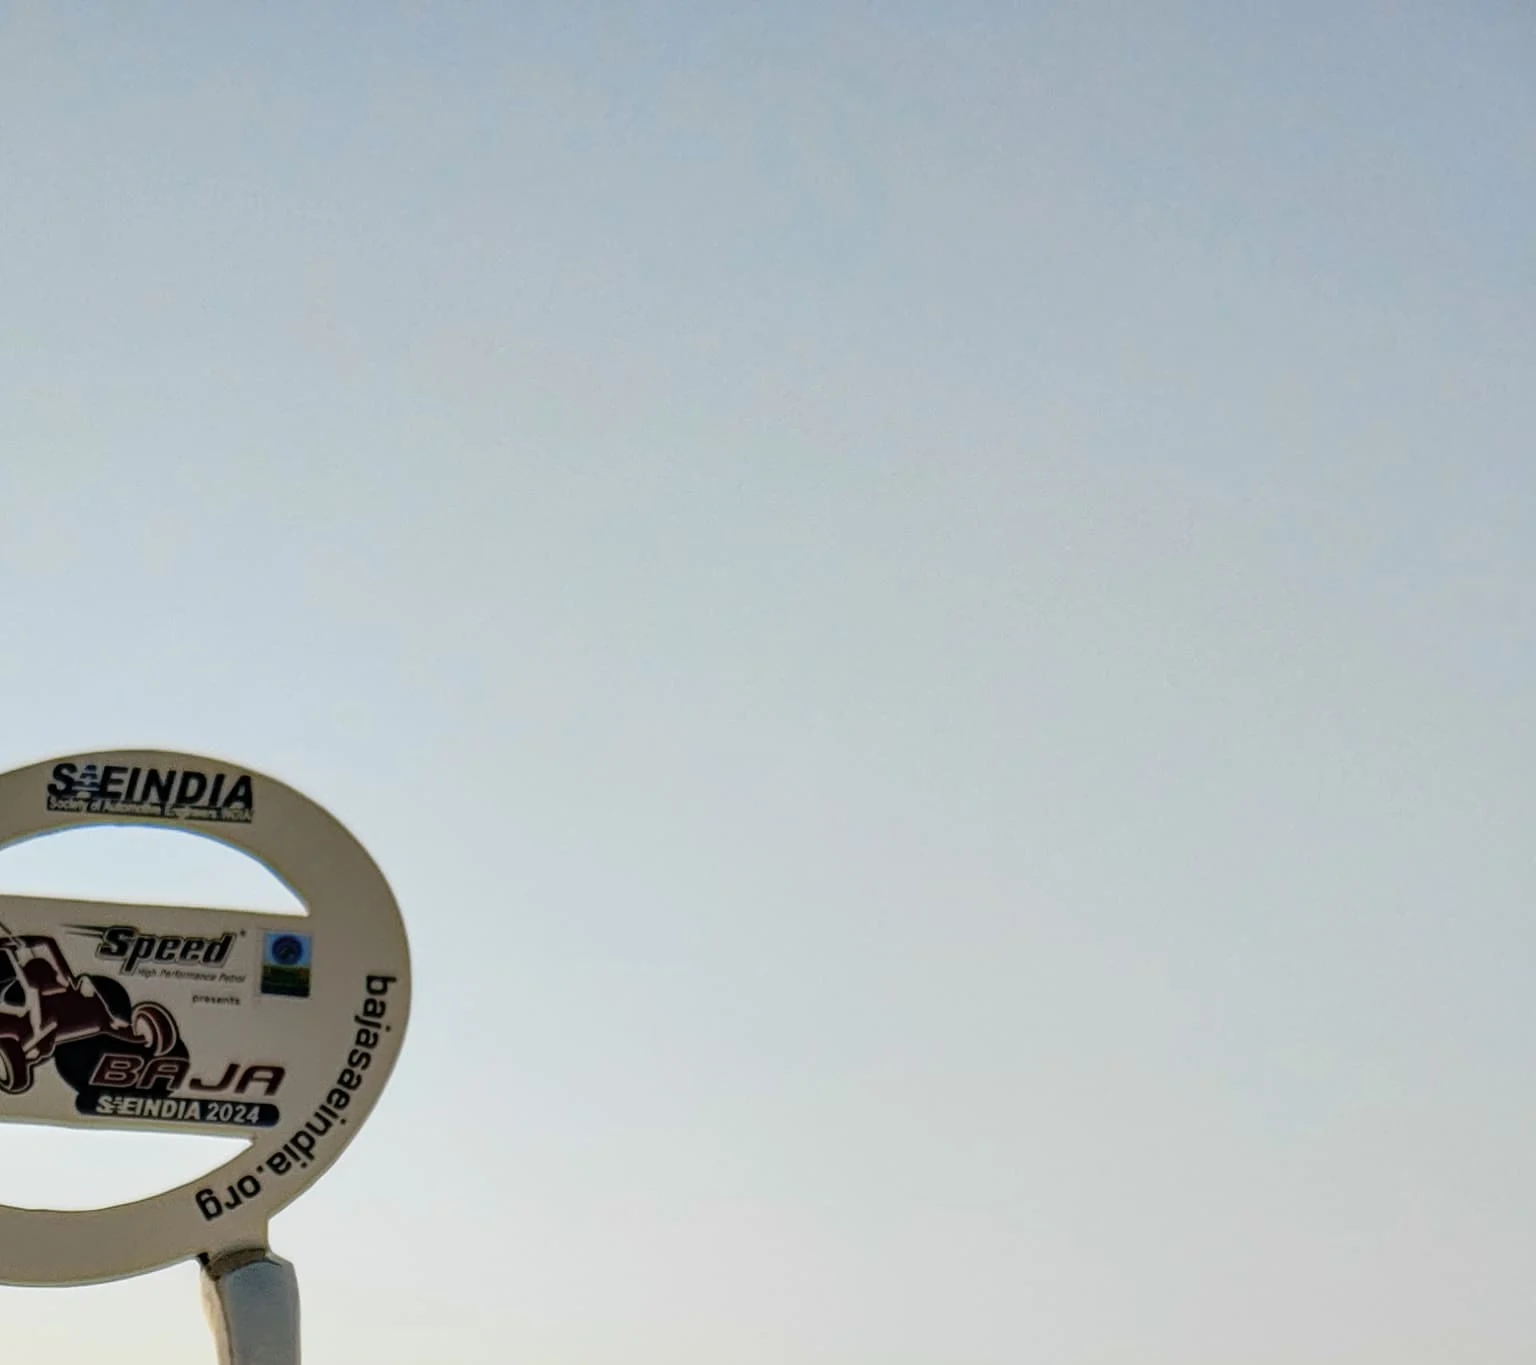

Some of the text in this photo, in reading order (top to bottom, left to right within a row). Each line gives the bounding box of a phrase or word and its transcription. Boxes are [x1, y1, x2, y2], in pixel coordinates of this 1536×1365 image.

[94, 925, 236, 975] Speed
[192, 994, 241, 1006] presents
[89, 1053, 286, 1096] BAJA
[195, 974, 397, 1221] bajasaeindia.org
[206, 1103, 261, 1124] 2024
